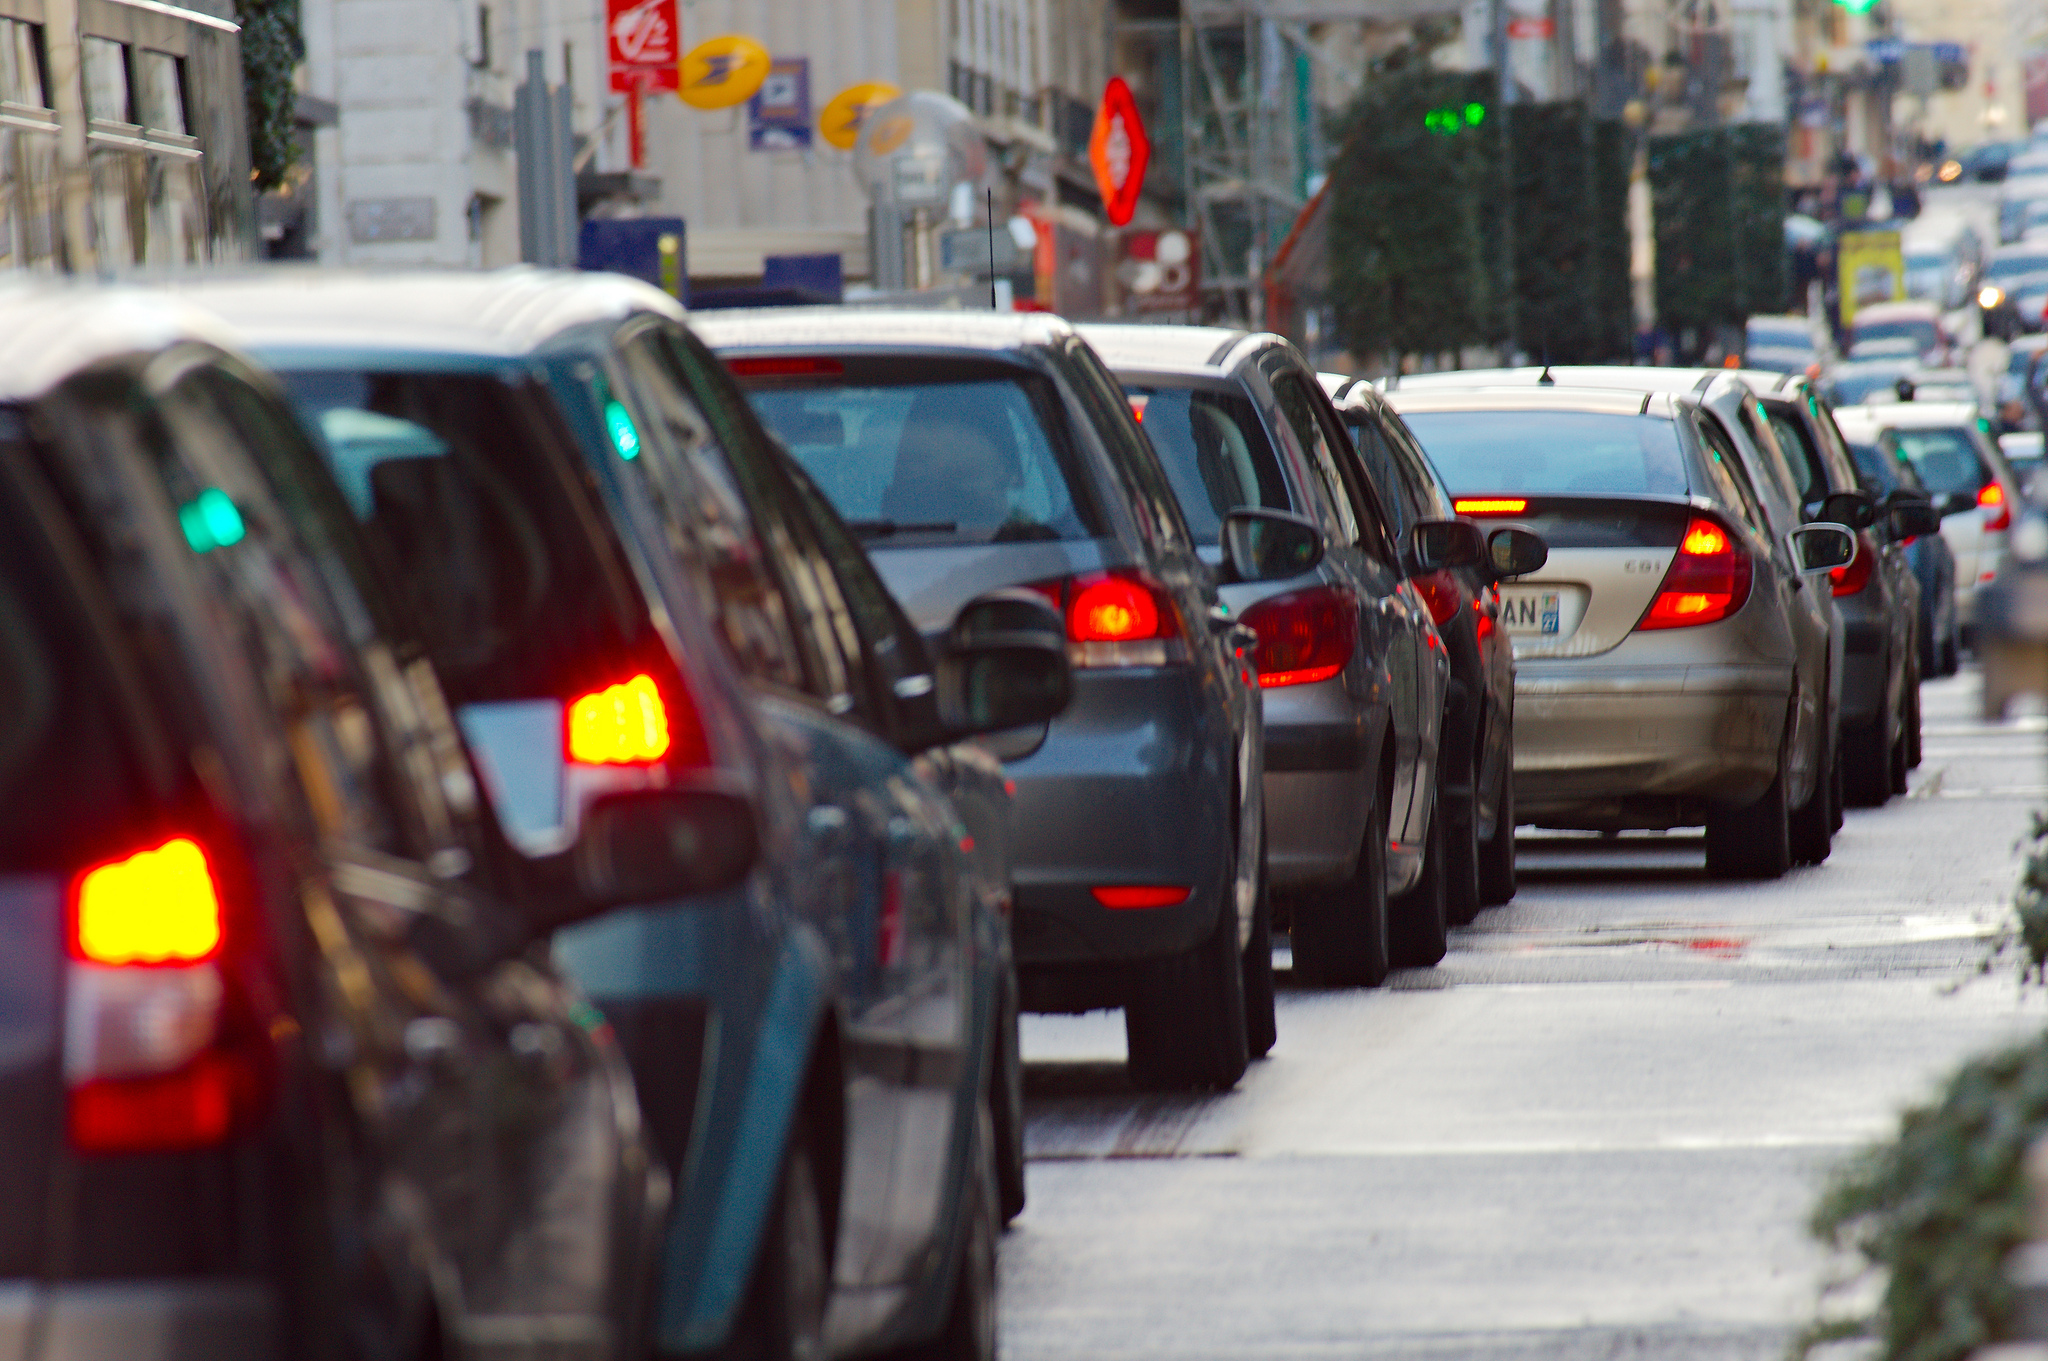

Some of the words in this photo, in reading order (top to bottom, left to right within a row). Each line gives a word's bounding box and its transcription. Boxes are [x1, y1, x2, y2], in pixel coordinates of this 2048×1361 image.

[1624, 559, 1660, 573] CDI
[1503, 597, 1536, 626] AN
[1543, 614, 1557, 631] 27
